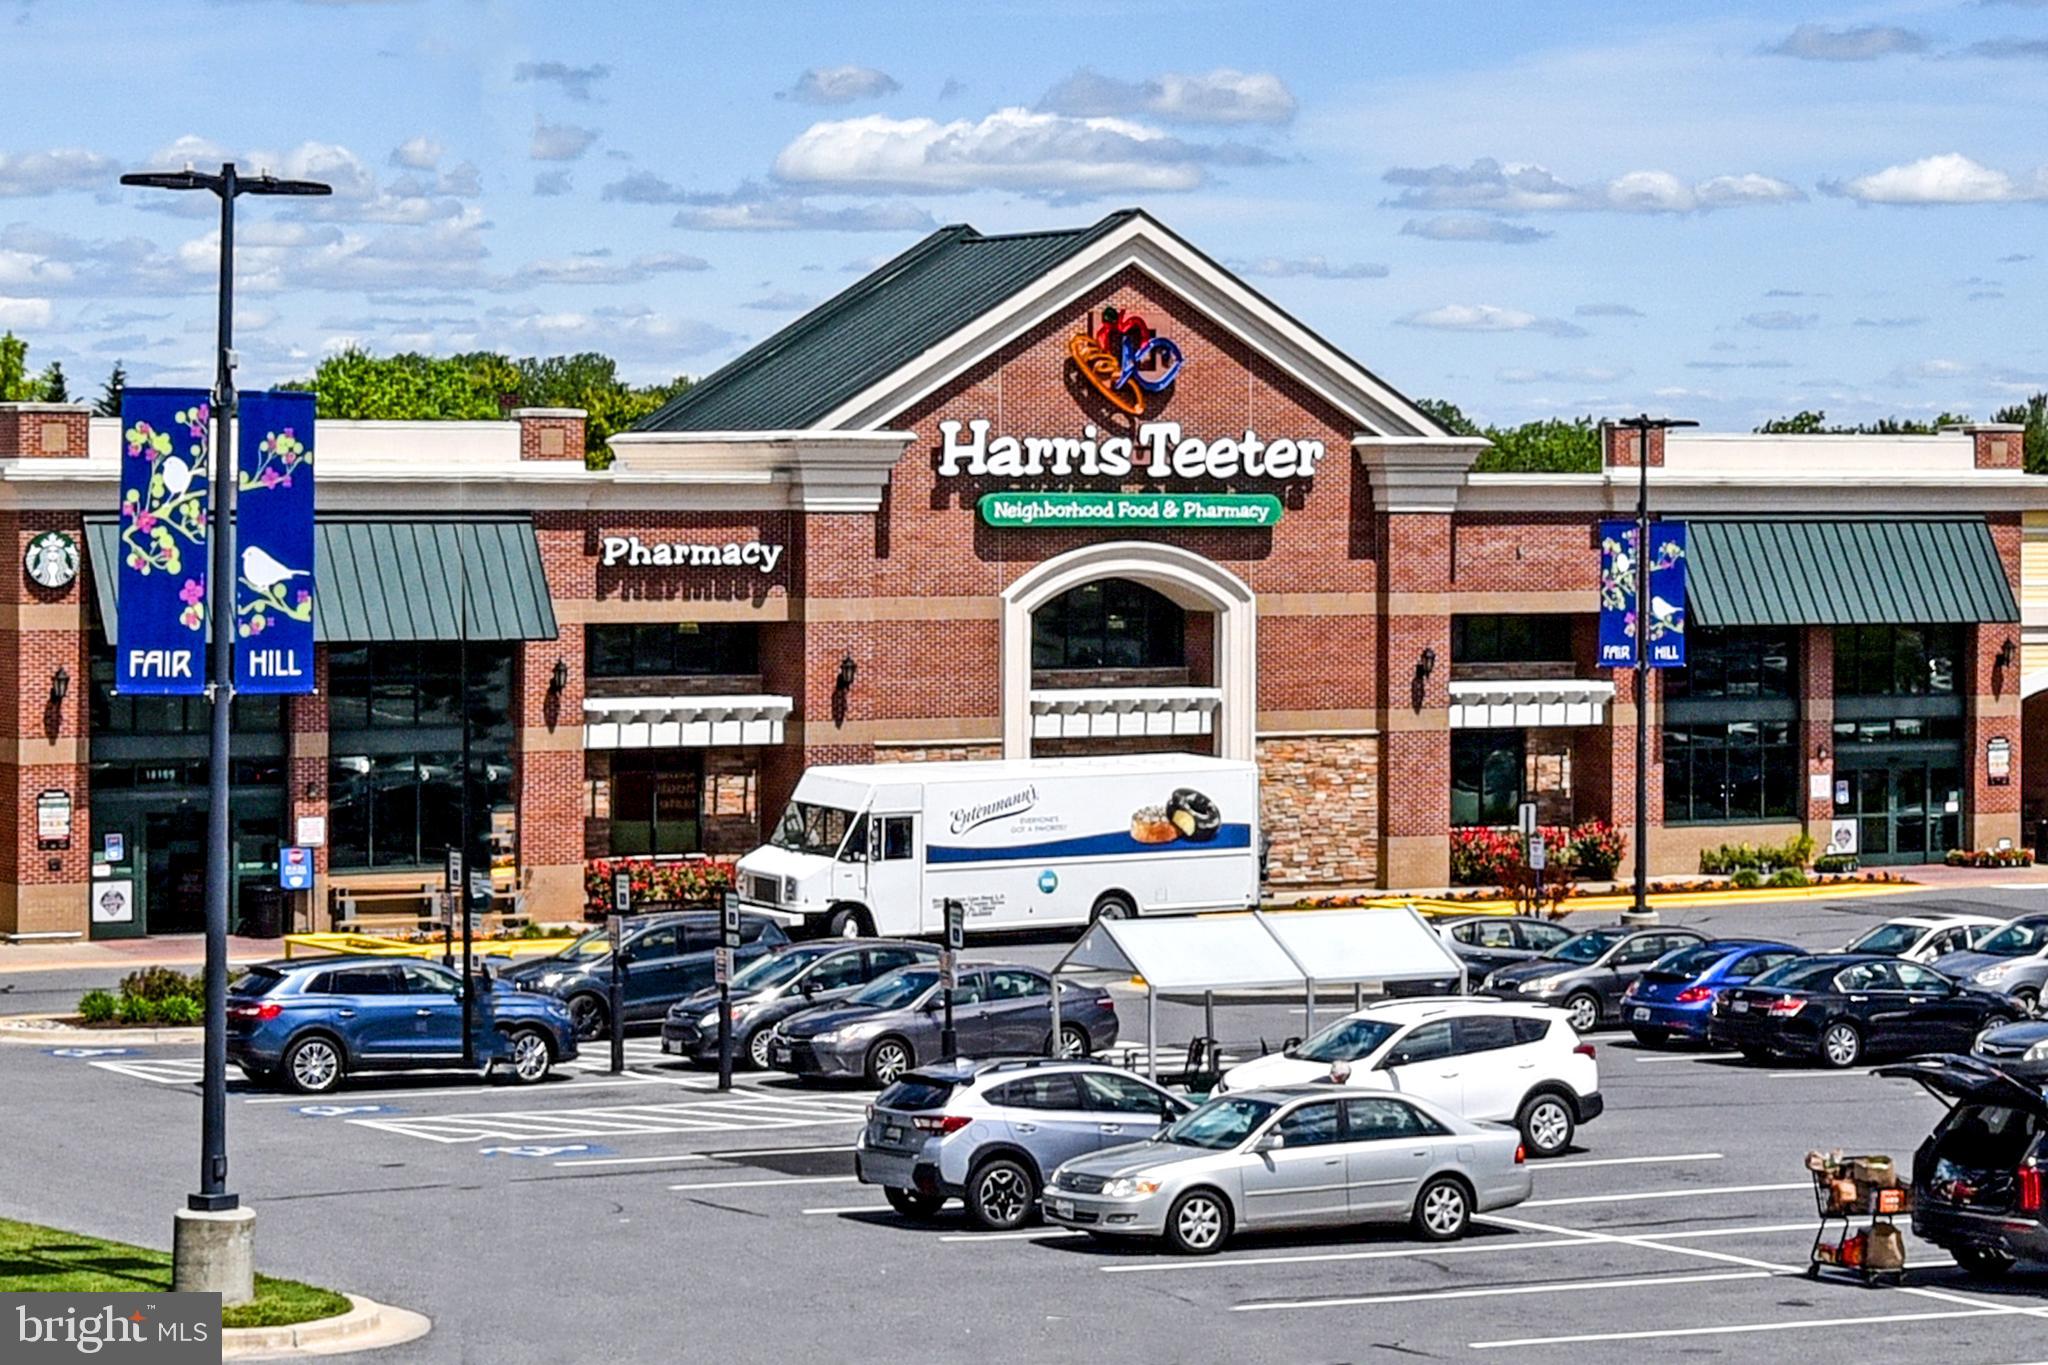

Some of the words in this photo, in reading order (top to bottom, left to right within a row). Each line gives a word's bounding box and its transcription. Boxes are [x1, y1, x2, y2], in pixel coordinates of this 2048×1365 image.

[938, 419, 1132, 478] Harris
[1138, 421, 1325, 479] Teeter
[994, 500, 1114, 523] Neighborhood
[1118, 500, 1159, 518] Food
[1162, 500, 1180, 519] &
[1183, 501, 1270, 523] Pharmacy
[602, 536, 783, 574] Pharmacy
[129, 650, 192, 678] FAIR
[249, 650, 302, 677] HILL
[1603, 645, 1631, 660] FAIR
[1654, 645, 1680, 660] HILL
